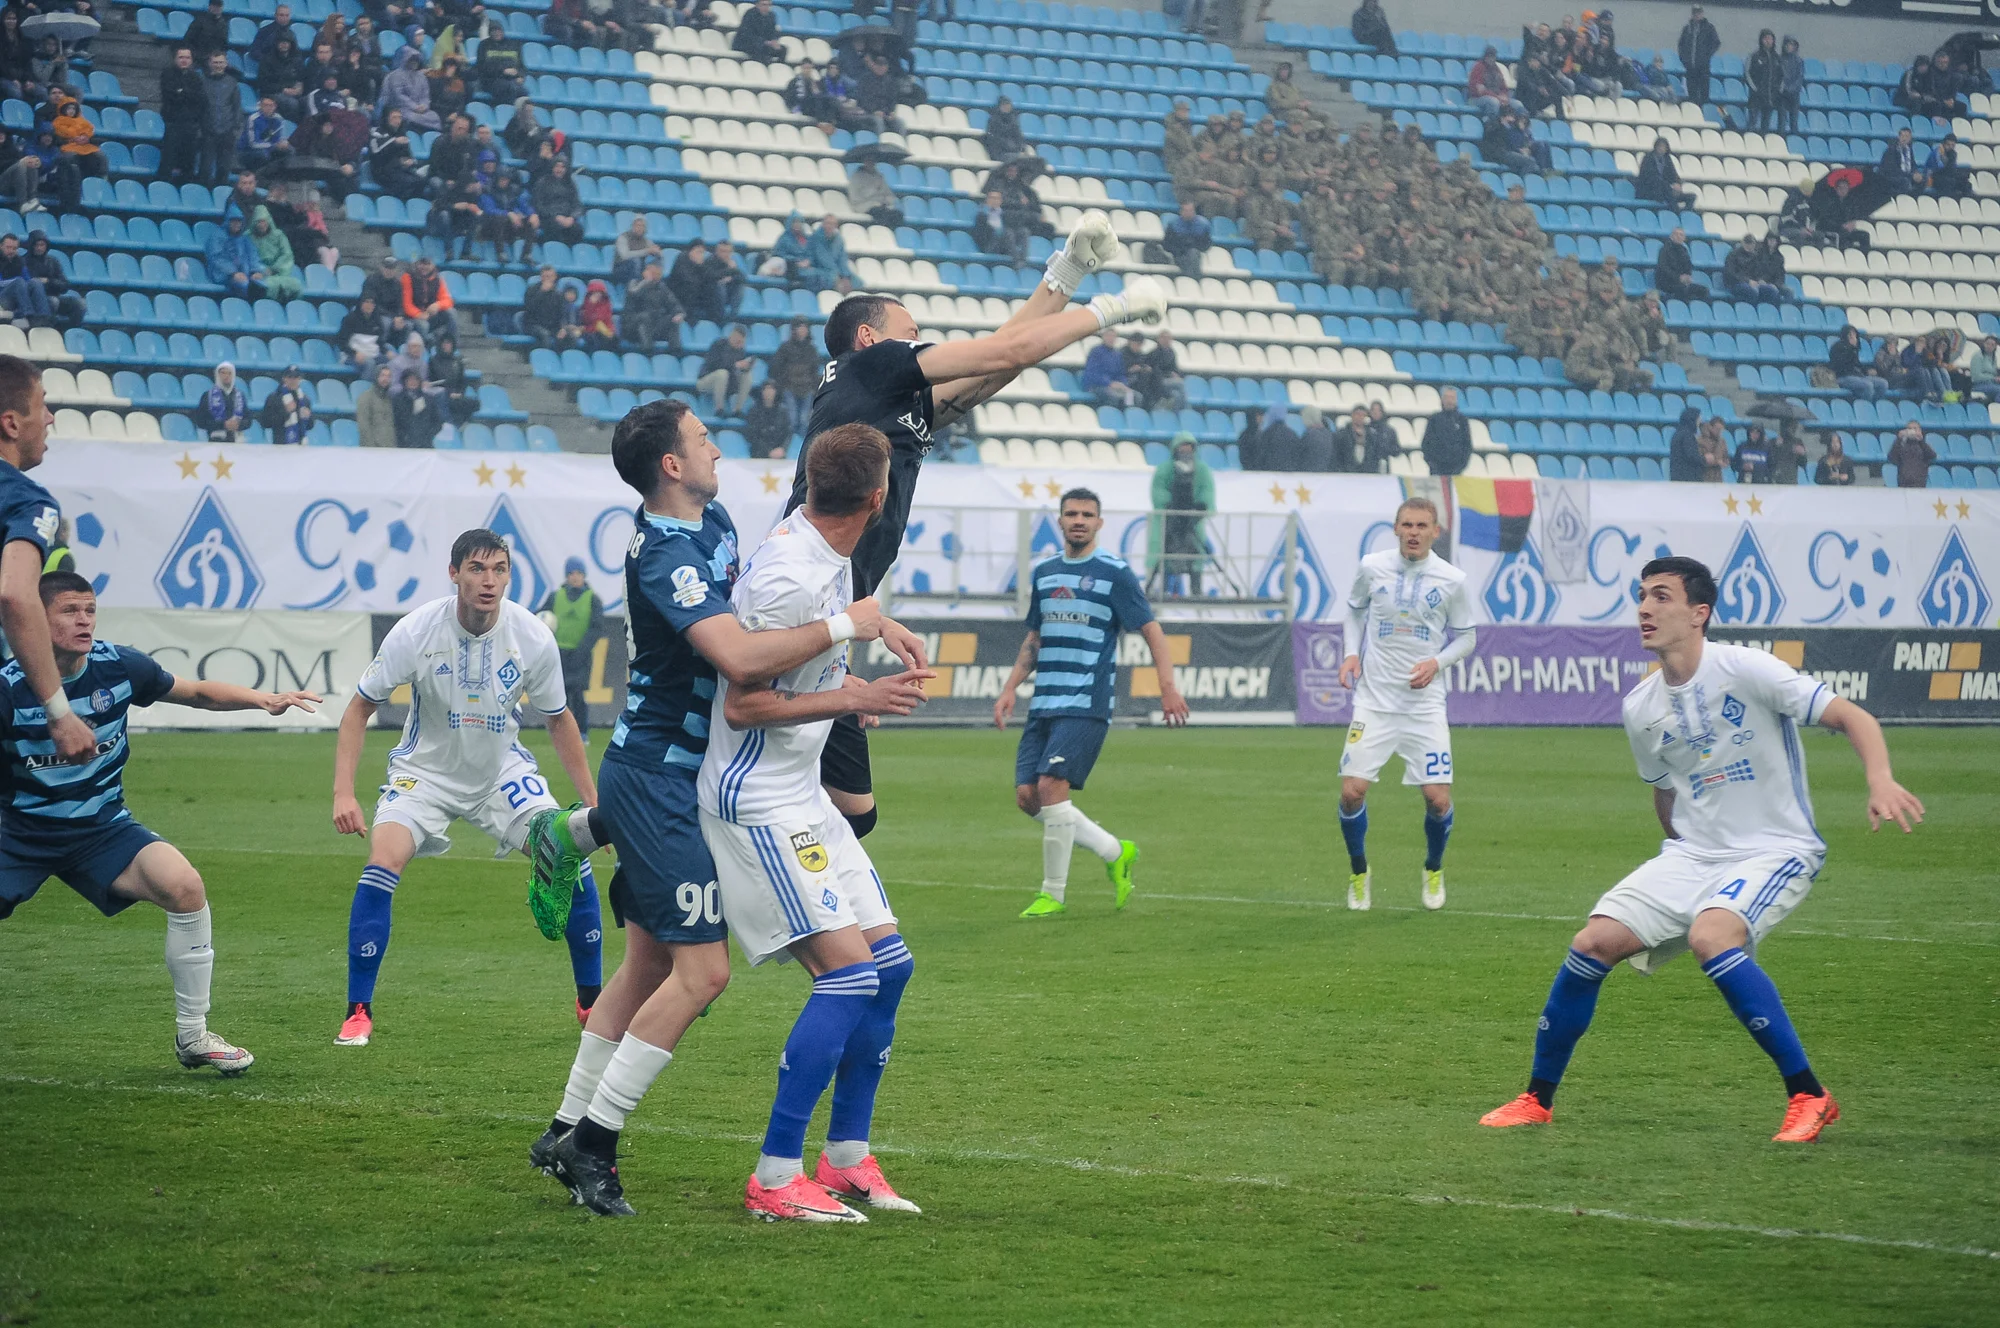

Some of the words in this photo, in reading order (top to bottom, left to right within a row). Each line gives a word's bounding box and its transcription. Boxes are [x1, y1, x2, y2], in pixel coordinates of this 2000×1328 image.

[1624, 661, 1648, 675] PARI
[1893, 642, 1950, 671] PARI
[1172, 667, 1270, 698] MATCH
[1426, 752, 1450, 776] 29
[501, 776, 544, 810] 20
[676, 880, 723, 926] 90
